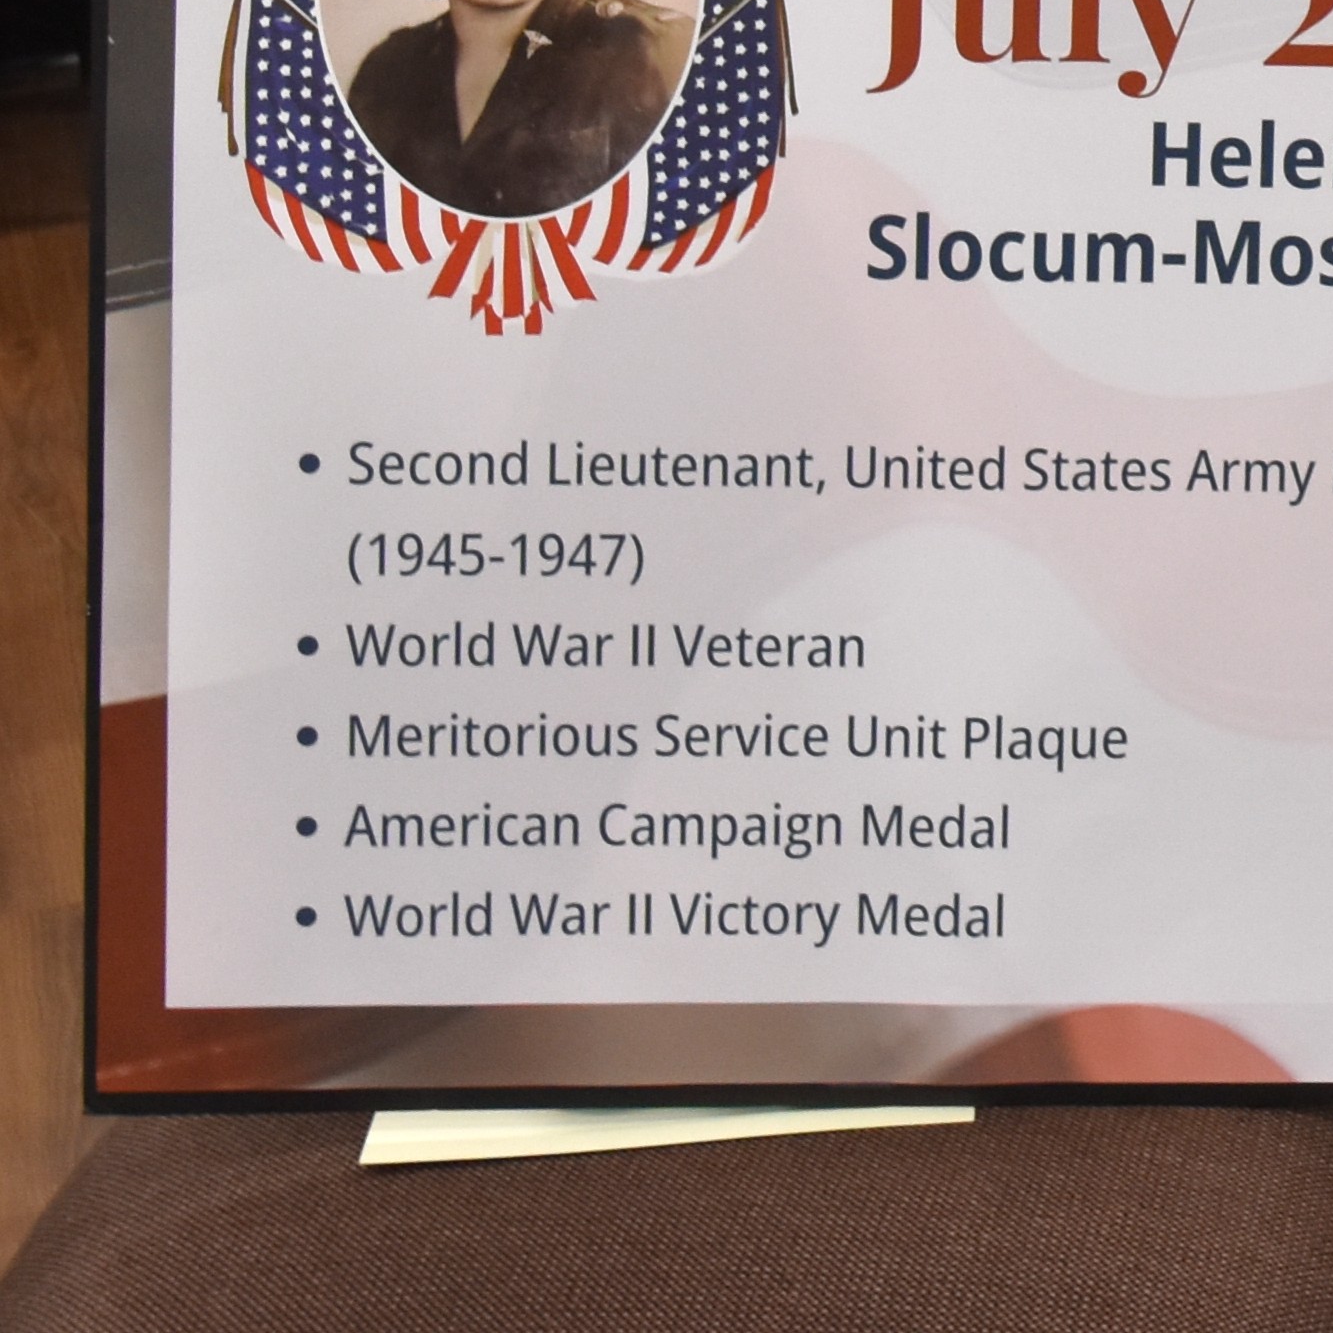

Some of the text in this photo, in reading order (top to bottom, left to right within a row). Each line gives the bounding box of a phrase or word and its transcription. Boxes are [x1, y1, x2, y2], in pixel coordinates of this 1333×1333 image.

[348, 439, 528, 487] Second
[548, 440, 826, 496] Lieutenant,
[846, 444, 1006, 492] United
[1023, 447, 1172, 493] States
[1185, 448, 1316, 507] Army
[347, 532, 644, 587] (1945-1947)
[345, 620, 865, 669] World War II Veteran
[348, 712, 1129, 774] Meritorious Service Unit Plaque
[343, 801, 1010, 860] American Campaign Medal
[343, 890, 1004, 949] World War II Victory Medal
